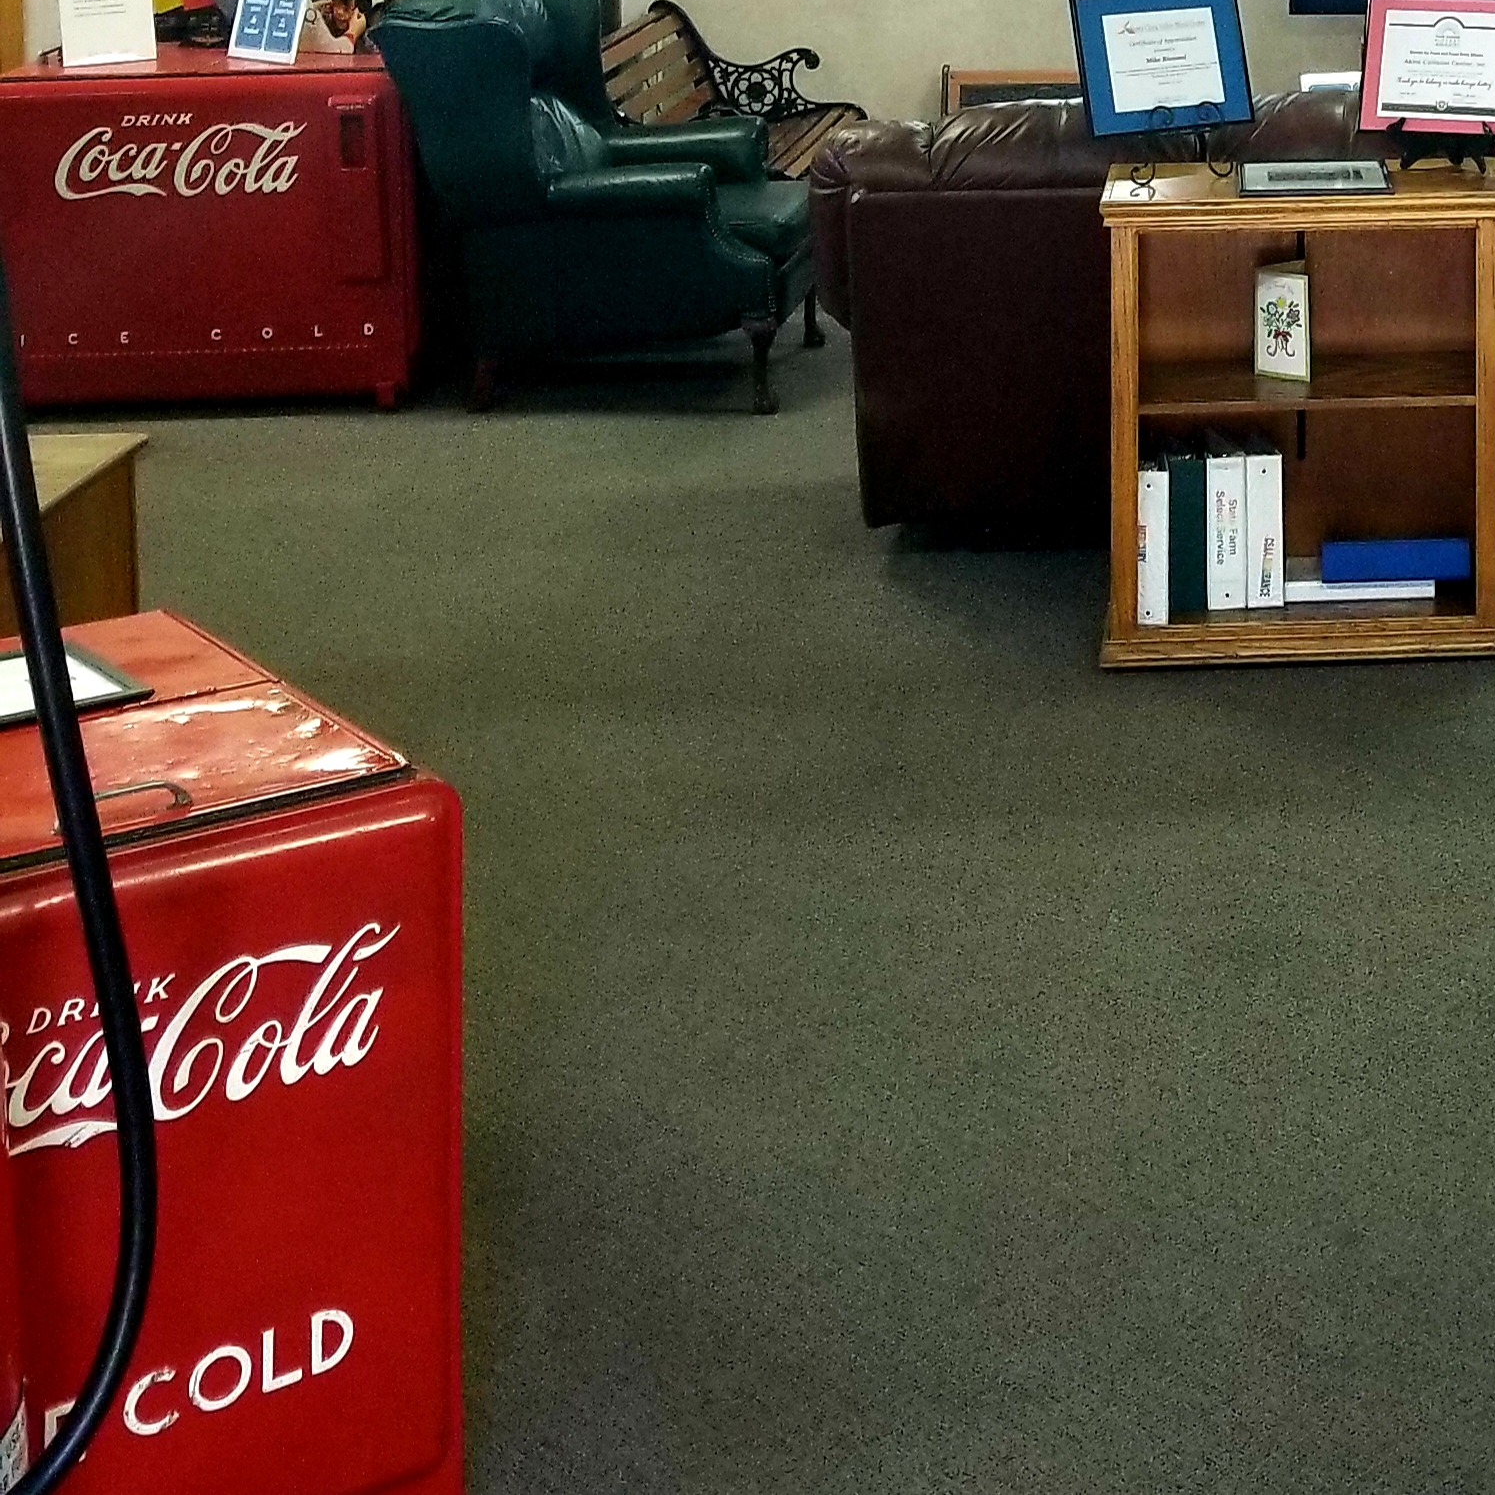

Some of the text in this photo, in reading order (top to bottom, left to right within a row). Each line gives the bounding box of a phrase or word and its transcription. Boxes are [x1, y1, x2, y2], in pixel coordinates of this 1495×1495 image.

[121, 112, 195, 128] DRINK
[54, 120, 308, 201] Coca-Cola
[210, 322, 376, 341] COLD
[1228, 499, 1238, 556] Stat Farm
[26, 973, 177, 1035] DRIK
[0, 921, 401, 1157] ca-Cola
[123, 1309, 355, 1435] COLD
